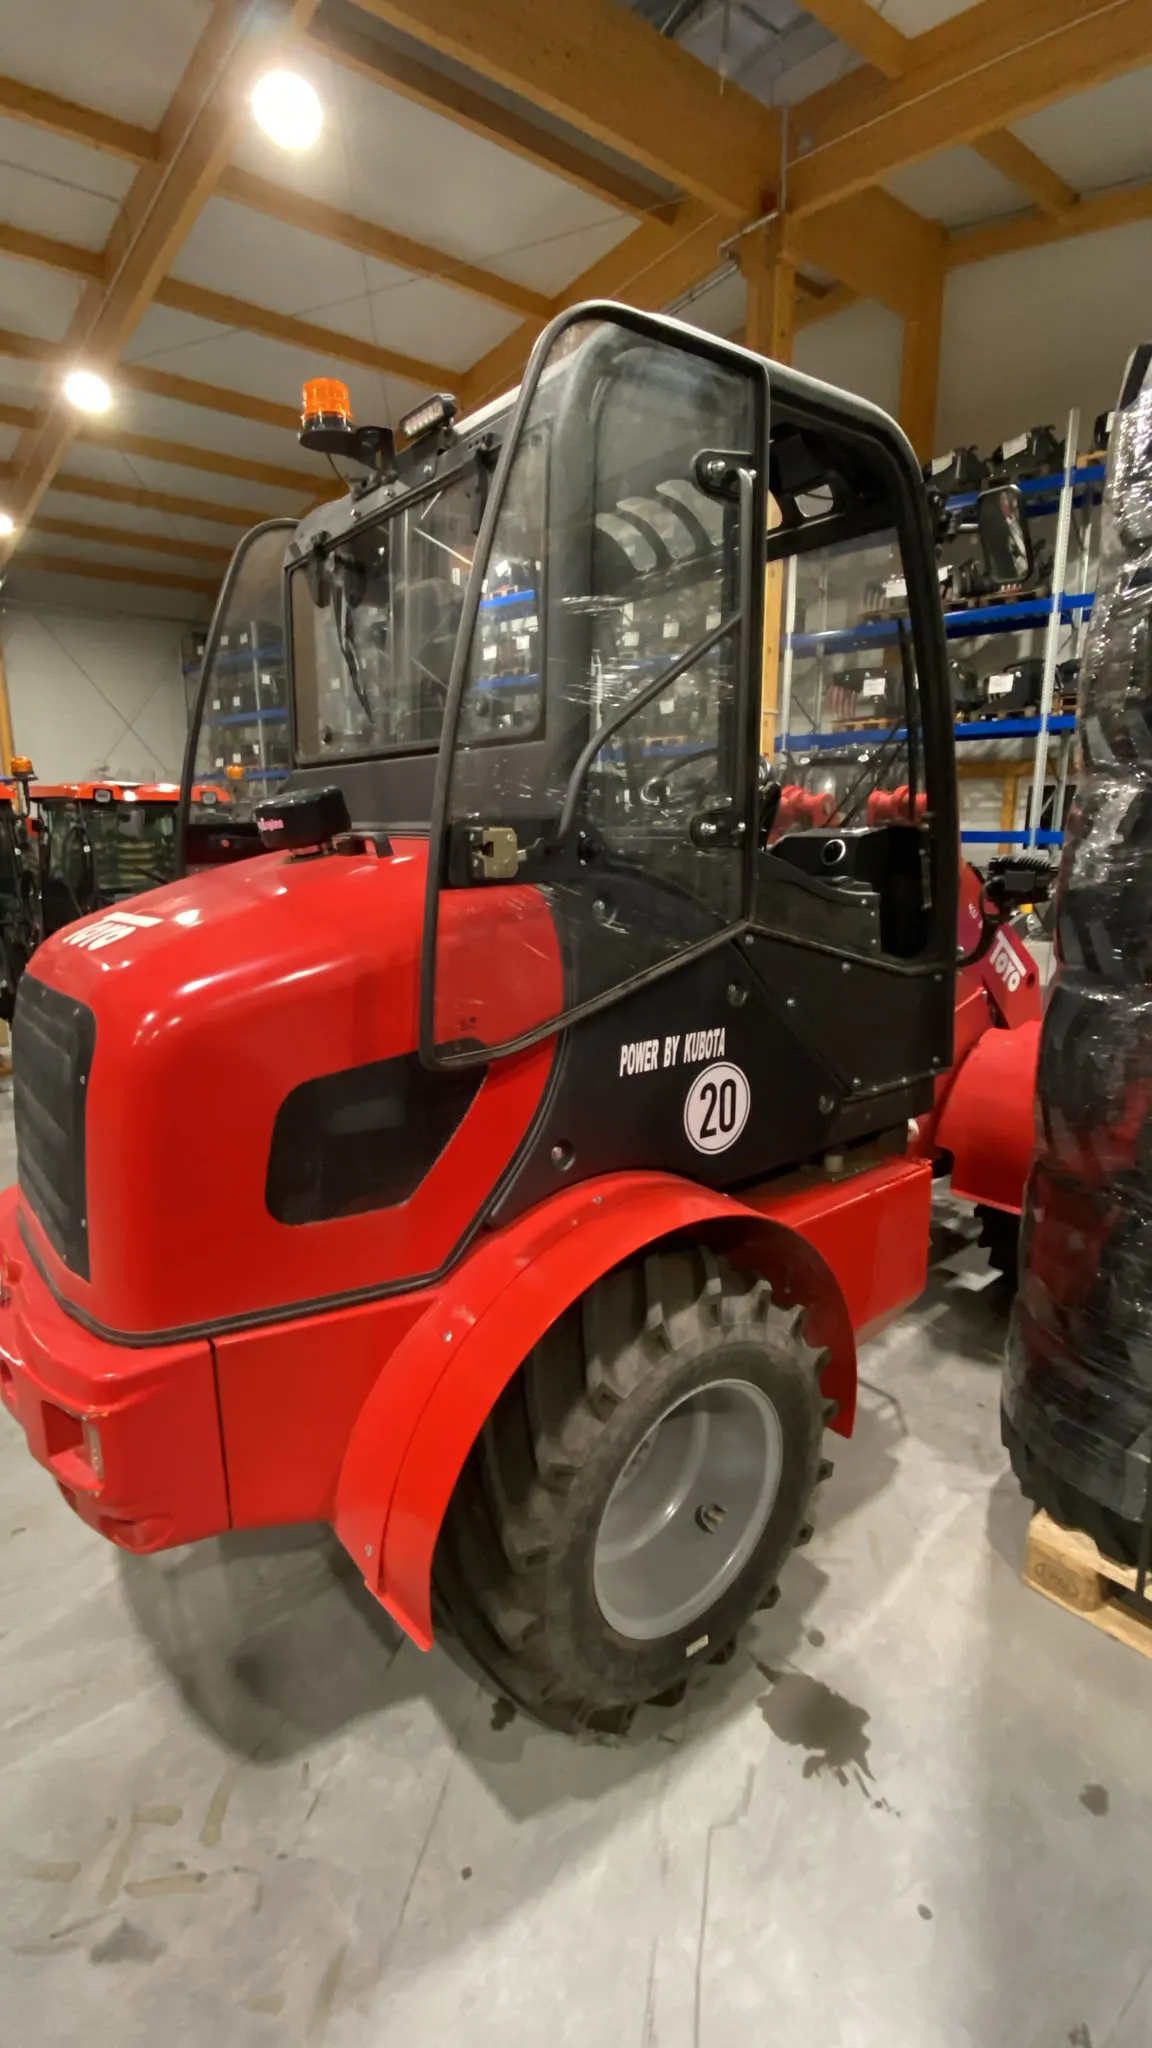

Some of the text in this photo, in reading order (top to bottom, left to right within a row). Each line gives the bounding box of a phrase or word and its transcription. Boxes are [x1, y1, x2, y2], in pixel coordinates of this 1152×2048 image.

[989, 930, 1027, 992] TOYO
[619, 1027, 726, 1078] POWER BY KUBOTA
[699, 1078, 737, 1139] 20
